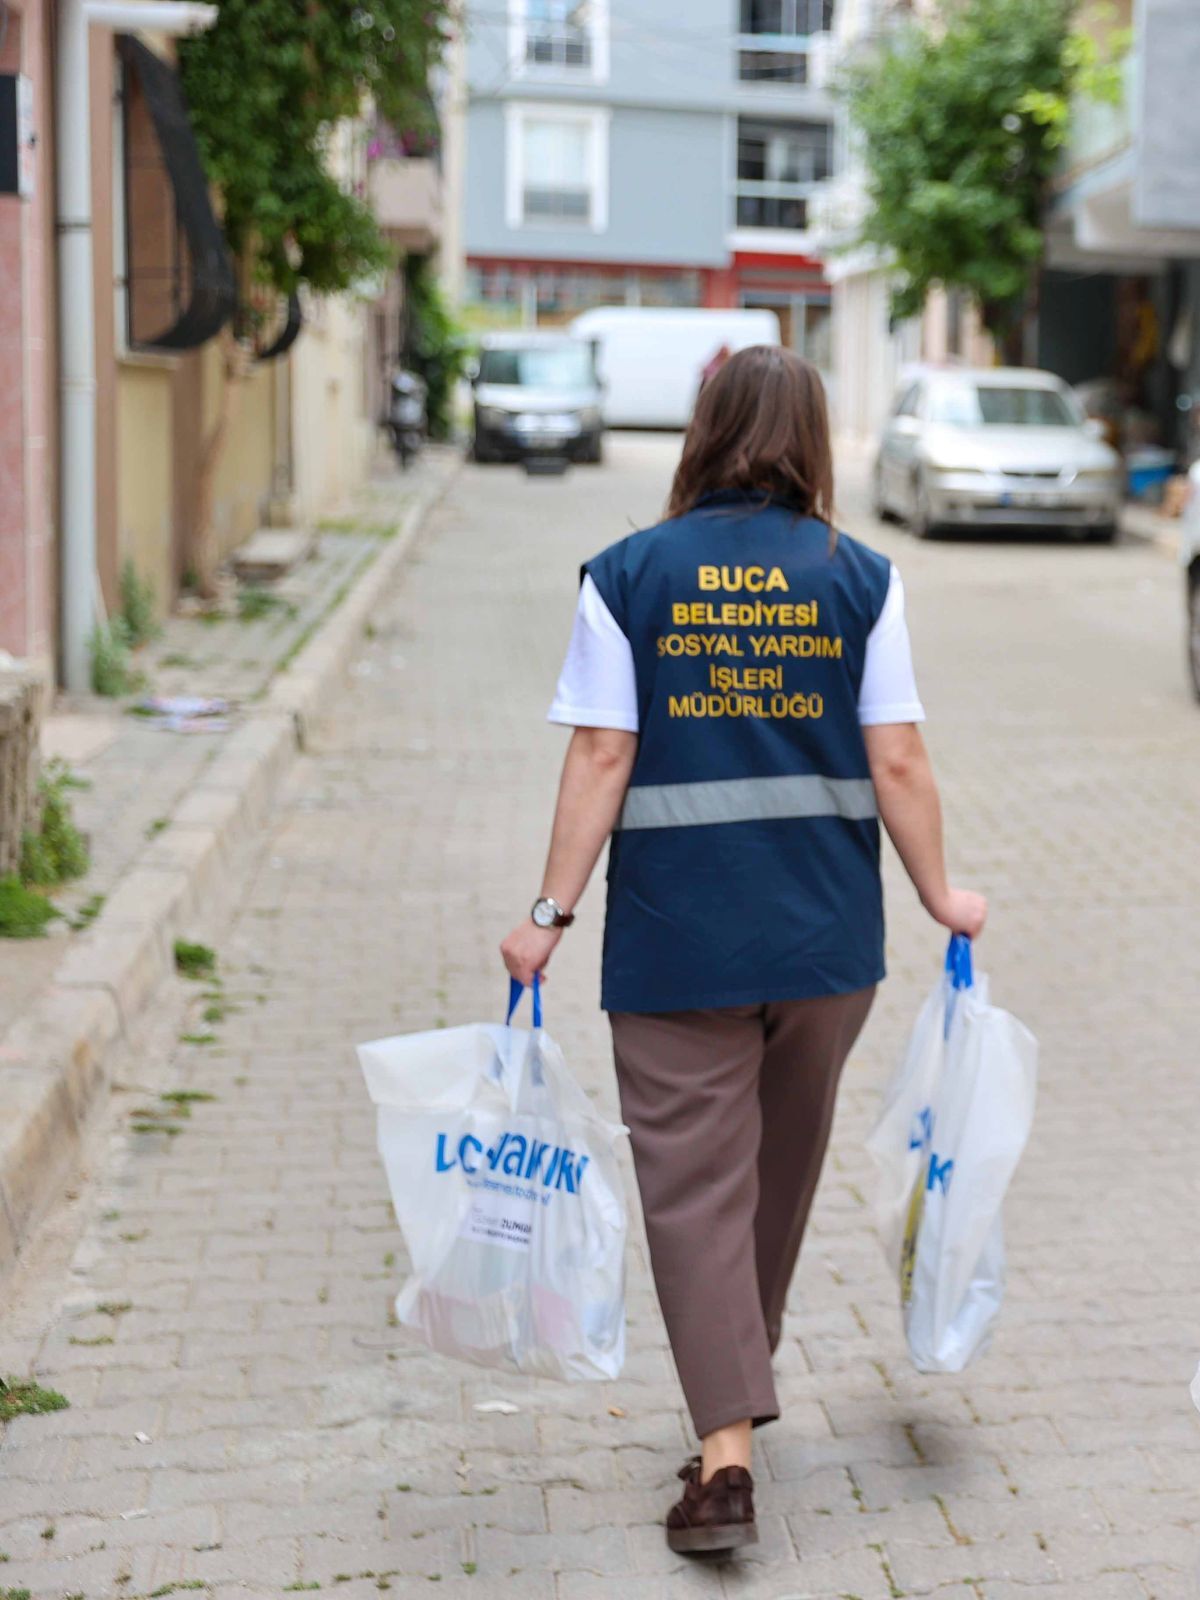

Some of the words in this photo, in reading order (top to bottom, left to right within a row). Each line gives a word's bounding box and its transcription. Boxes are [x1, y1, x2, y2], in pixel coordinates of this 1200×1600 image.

[698, 565, 789, 592] BUCA
[671, 600, 818, 626] BELEDİYESİ
[656, 633, 744, 657] SOSYAL
[748, 635, 843, 659] YARDIM
[709, 663, 783, 692] İŞLERİ
[668, 691, 824, 719] MÜDÜRLÜĞÜ
